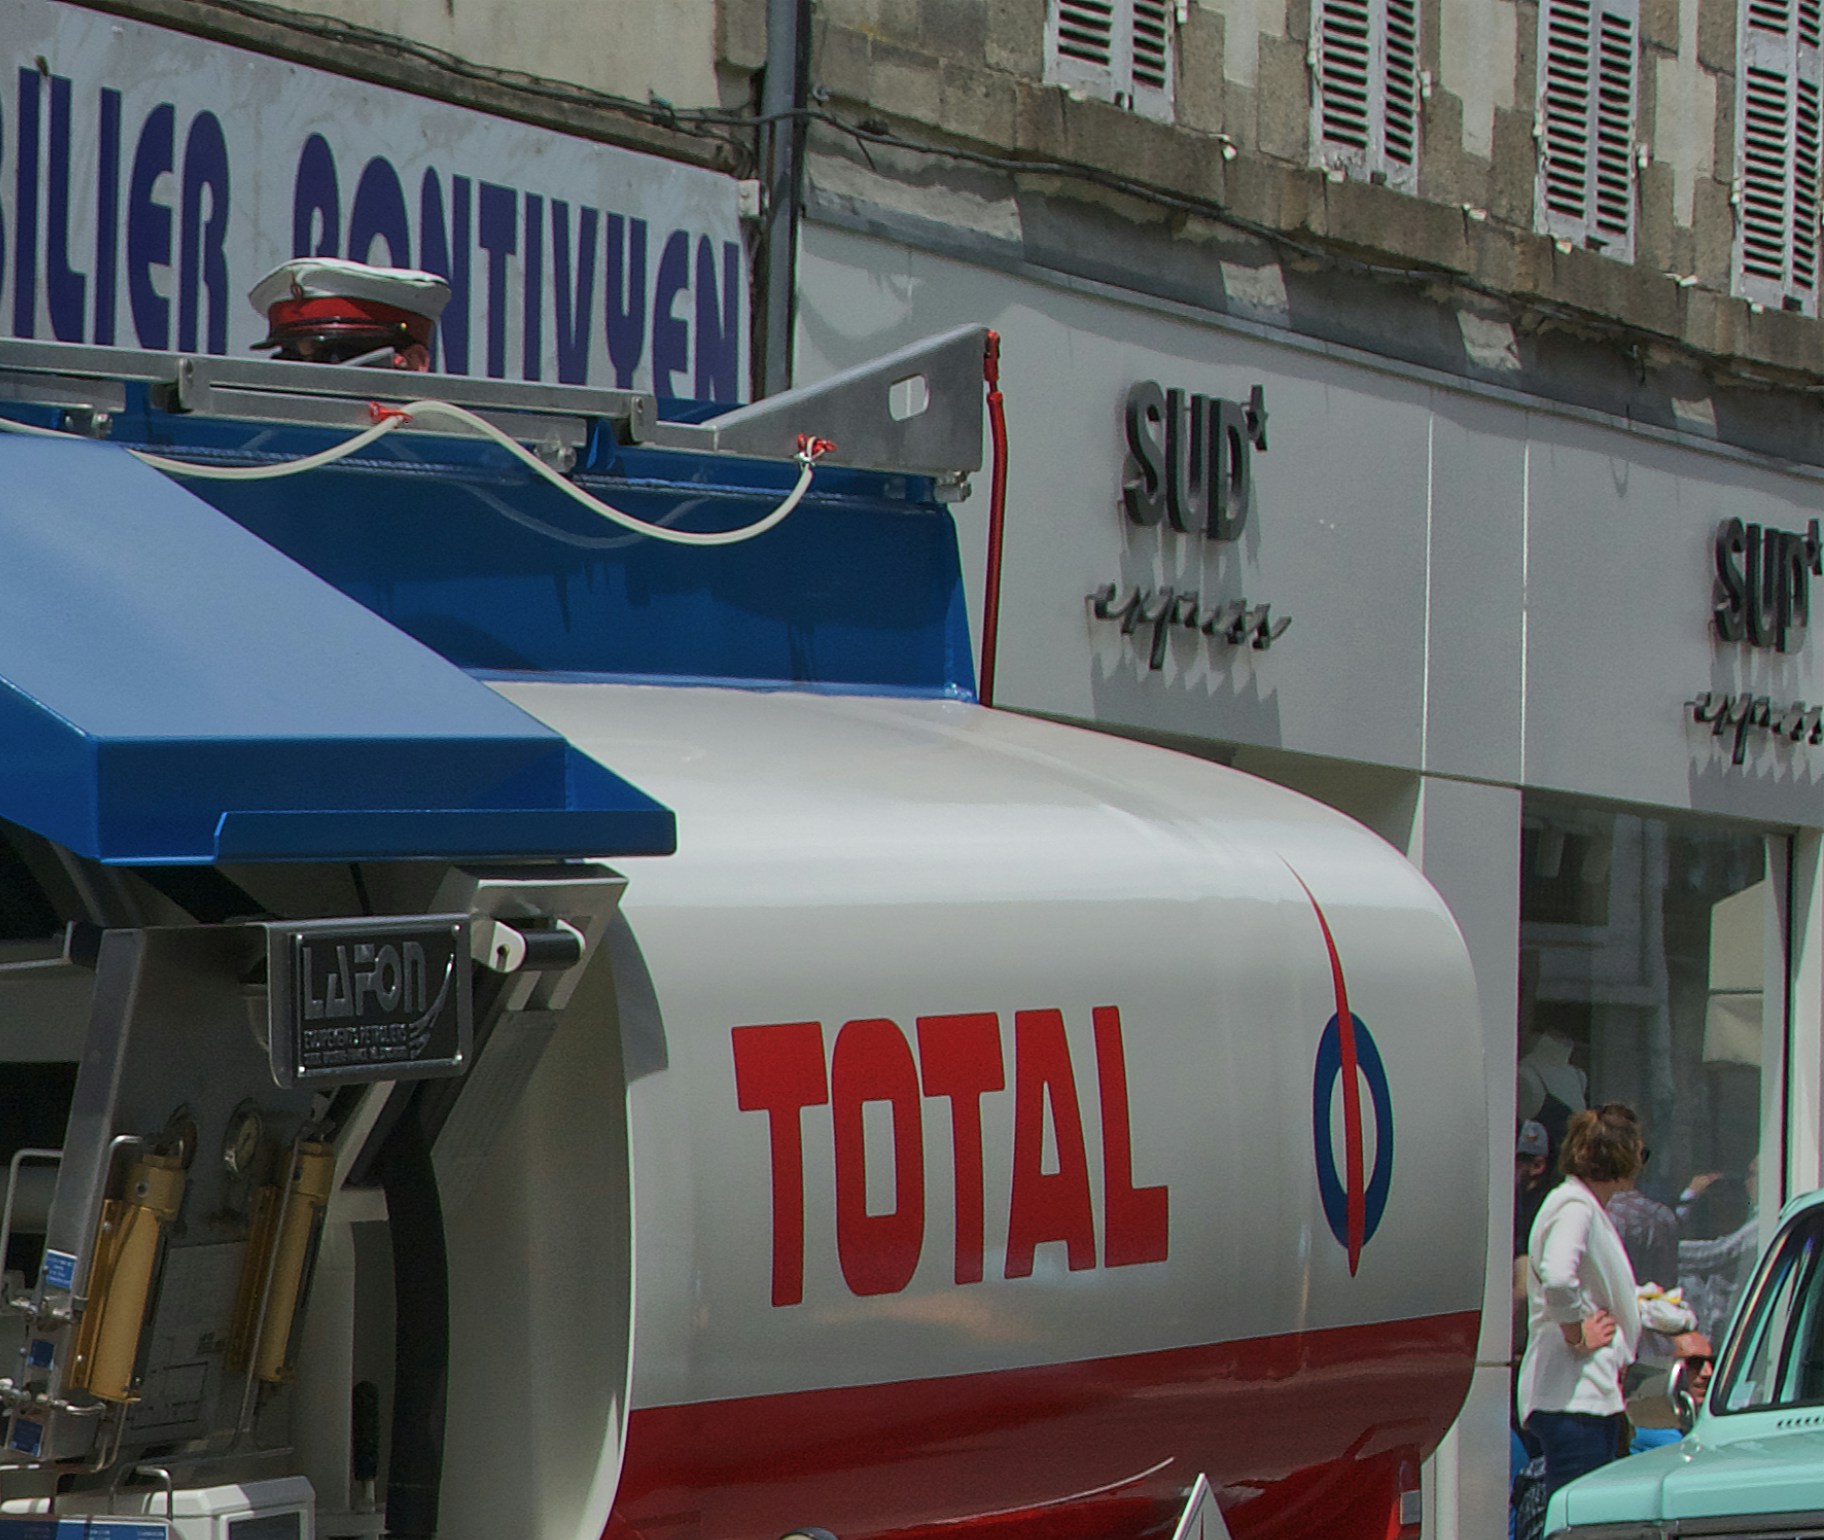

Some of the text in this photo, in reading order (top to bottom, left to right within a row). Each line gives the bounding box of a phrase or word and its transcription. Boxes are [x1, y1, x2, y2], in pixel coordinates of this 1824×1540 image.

[1121, 379, 1251, 542] SUD
[1711, 516, 1810, 653] SUD
[302, 941, 427, 1020] LAFON
[731, 1005, 1169, 1308] TOTAL
